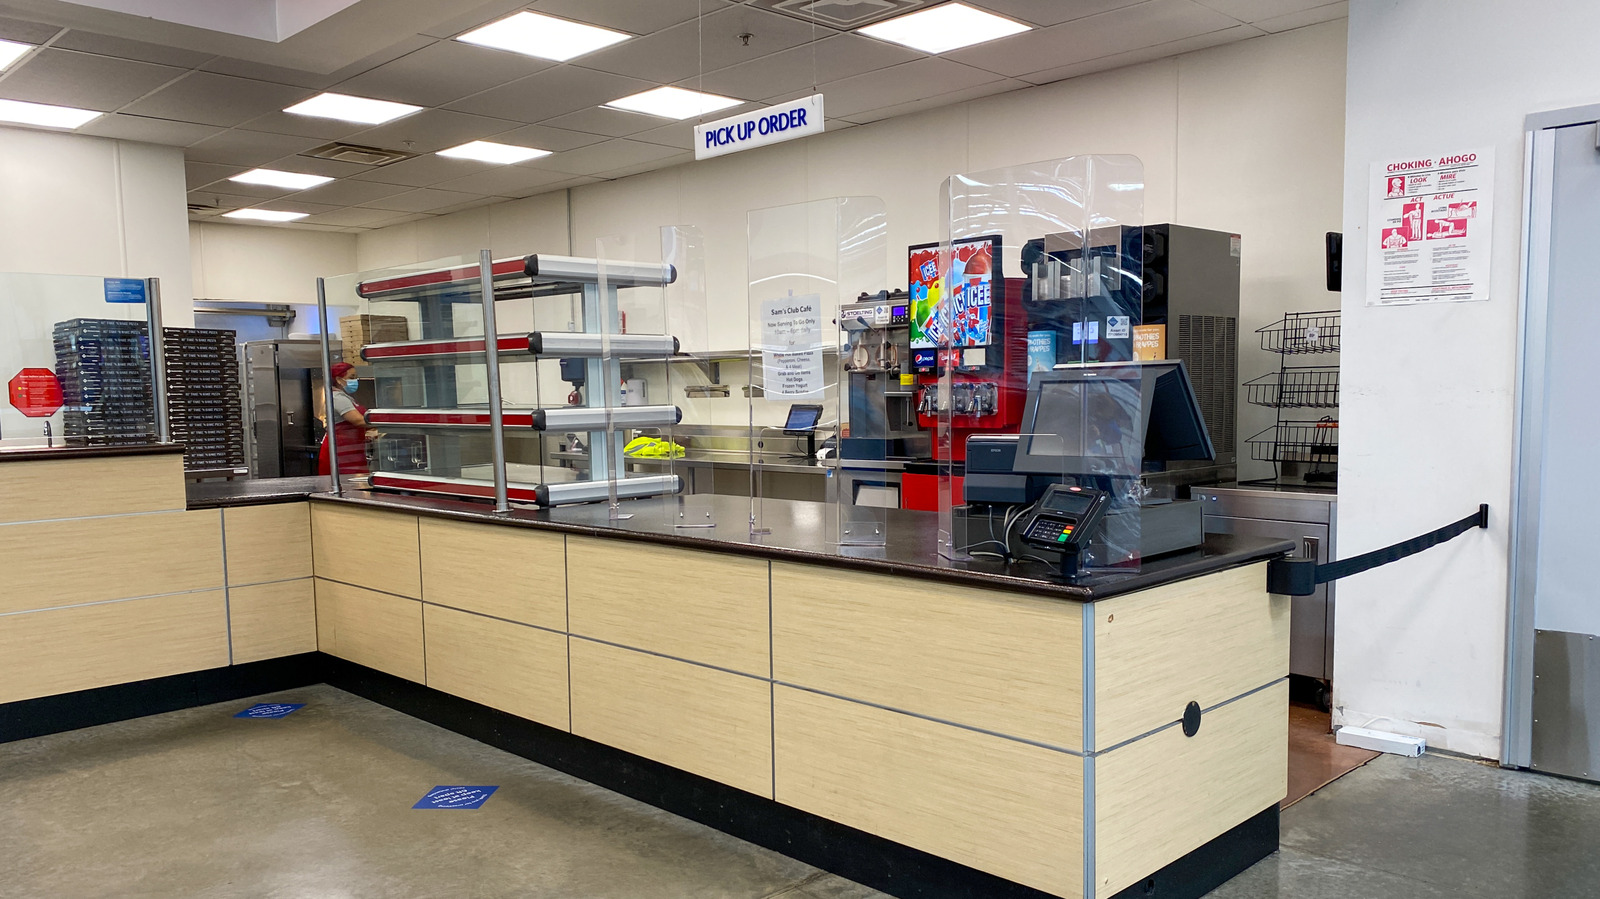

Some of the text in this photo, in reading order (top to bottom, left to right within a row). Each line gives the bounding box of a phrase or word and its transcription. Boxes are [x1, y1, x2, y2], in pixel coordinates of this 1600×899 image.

[706, 108, 807, 148] PICK UP ORDER
[1387, 153, 1476, 171] CHOKING AHOGO
[922, 261, 937, 276] ICEE
[967, 283, 991, 307] ICEE
